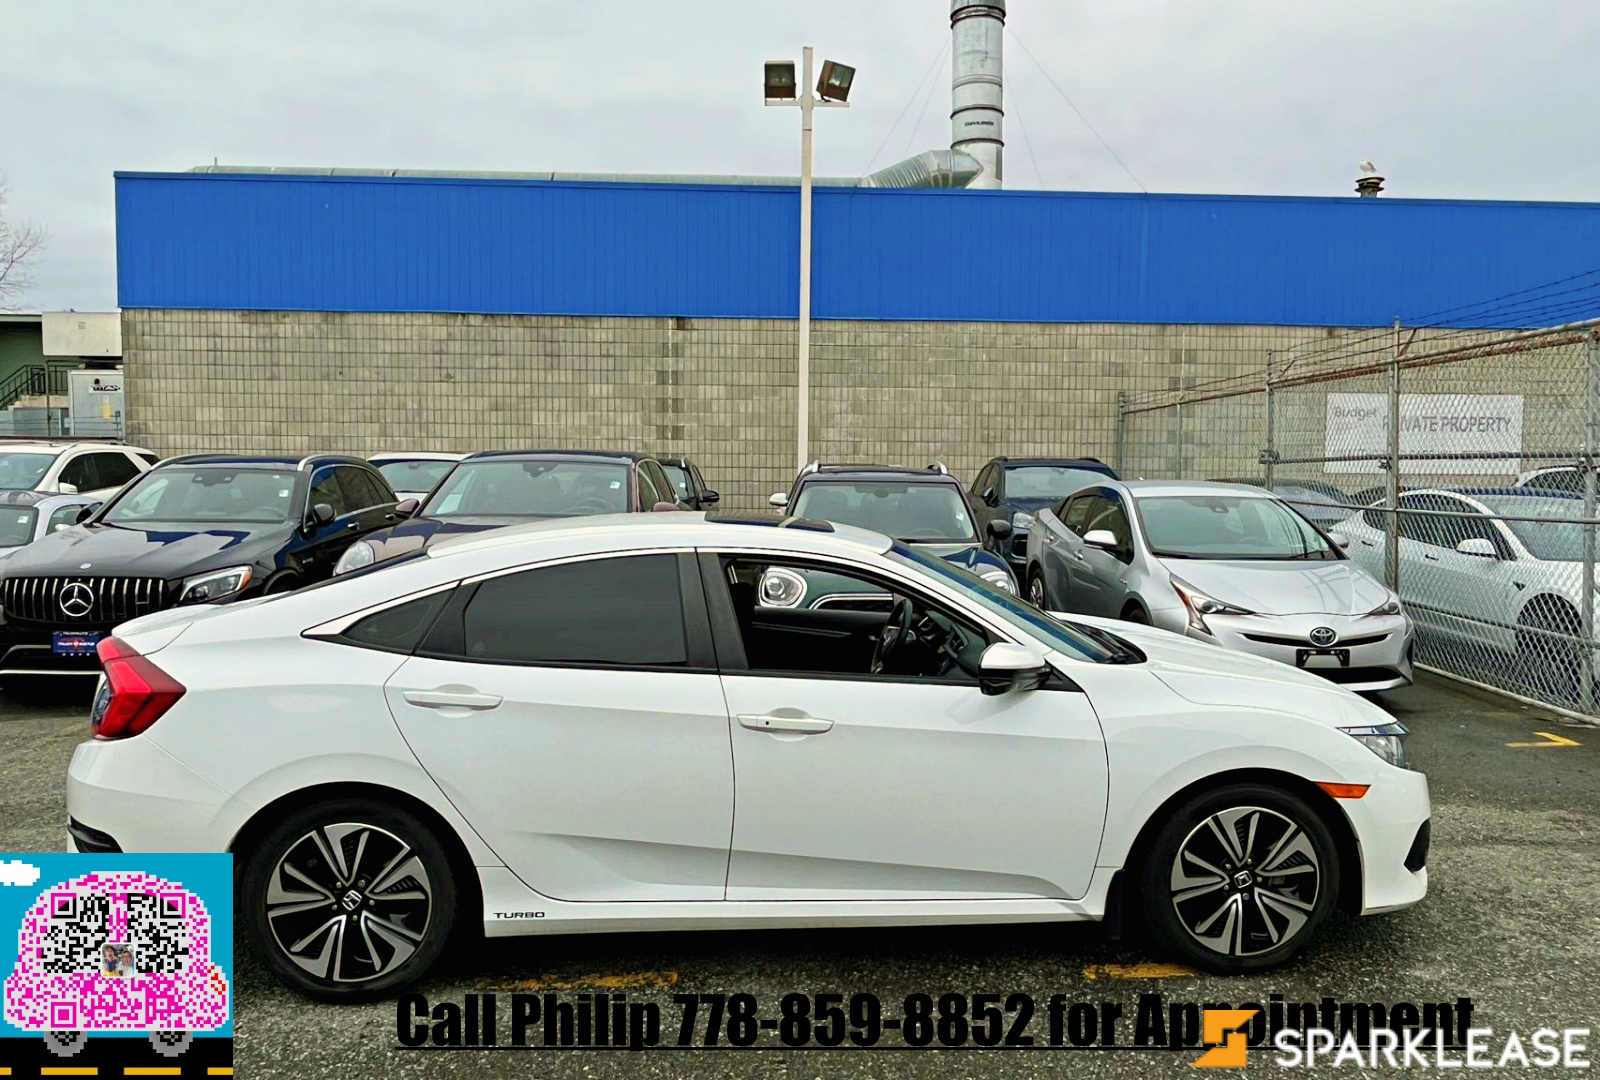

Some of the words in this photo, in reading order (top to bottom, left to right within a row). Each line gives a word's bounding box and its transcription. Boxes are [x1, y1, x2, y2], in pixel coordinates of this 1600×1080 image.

[1335, 406, 1377, 421] Budget
[1382, 415, 1438, 432] PIVATE
[1439, 416, 1511, 433] PROPERTY
[493, 911, 545, 919] TURBO
